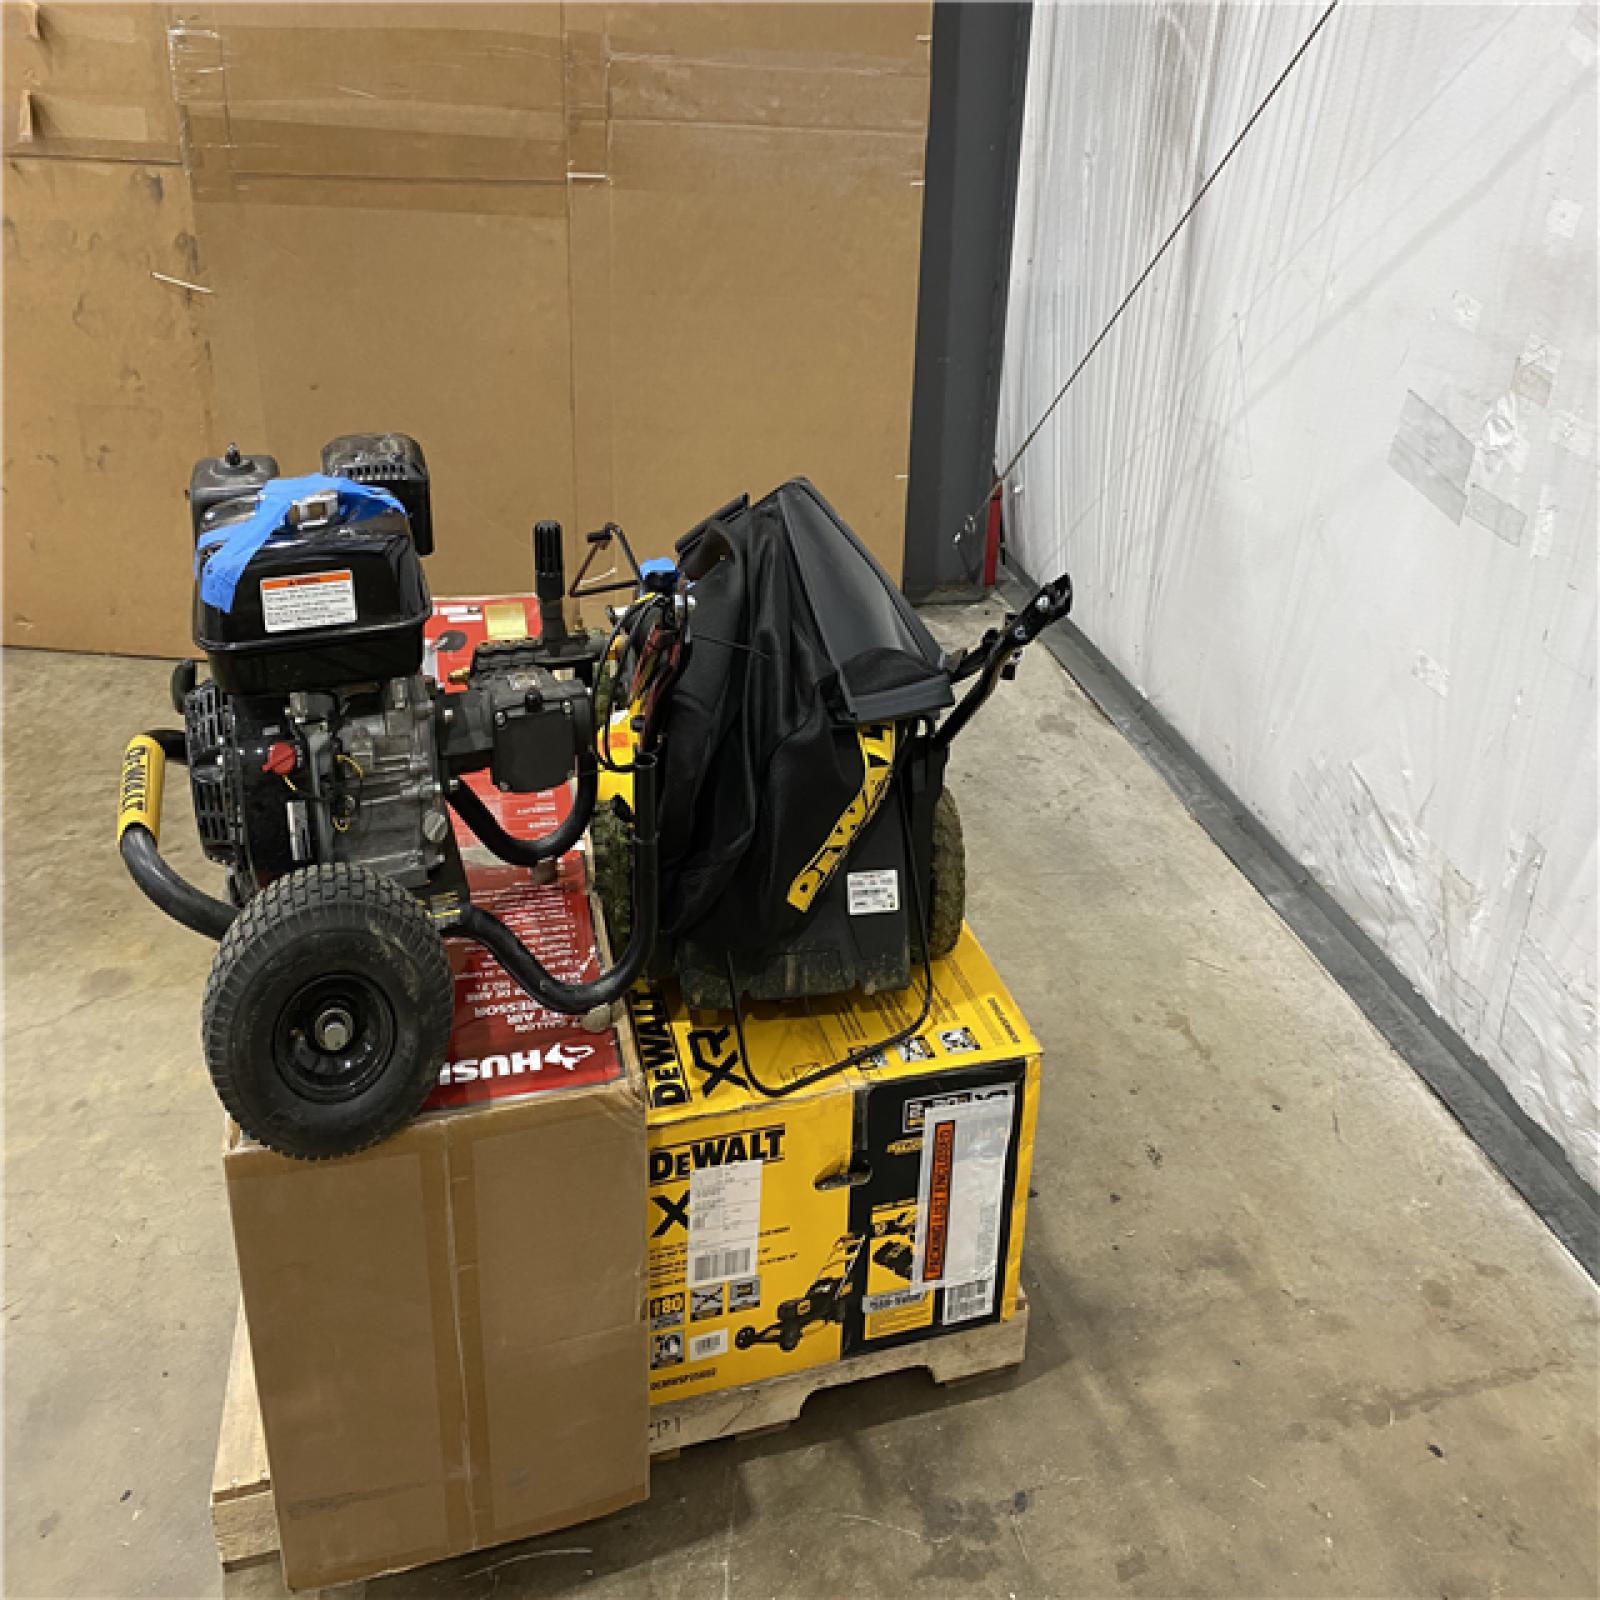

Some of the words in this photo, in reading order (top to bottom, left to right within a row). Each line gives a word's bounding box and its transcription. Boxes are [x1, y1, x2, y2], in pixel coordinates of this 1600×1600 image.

[507, 1011, 535, 1025] AIR
[439, 1049, 543, 1085] HUS
[687, 1025, 752, 1098] XR
[650, 1130, 785, 1181] DEWALT
[650, 1190, 688, 1238] X
